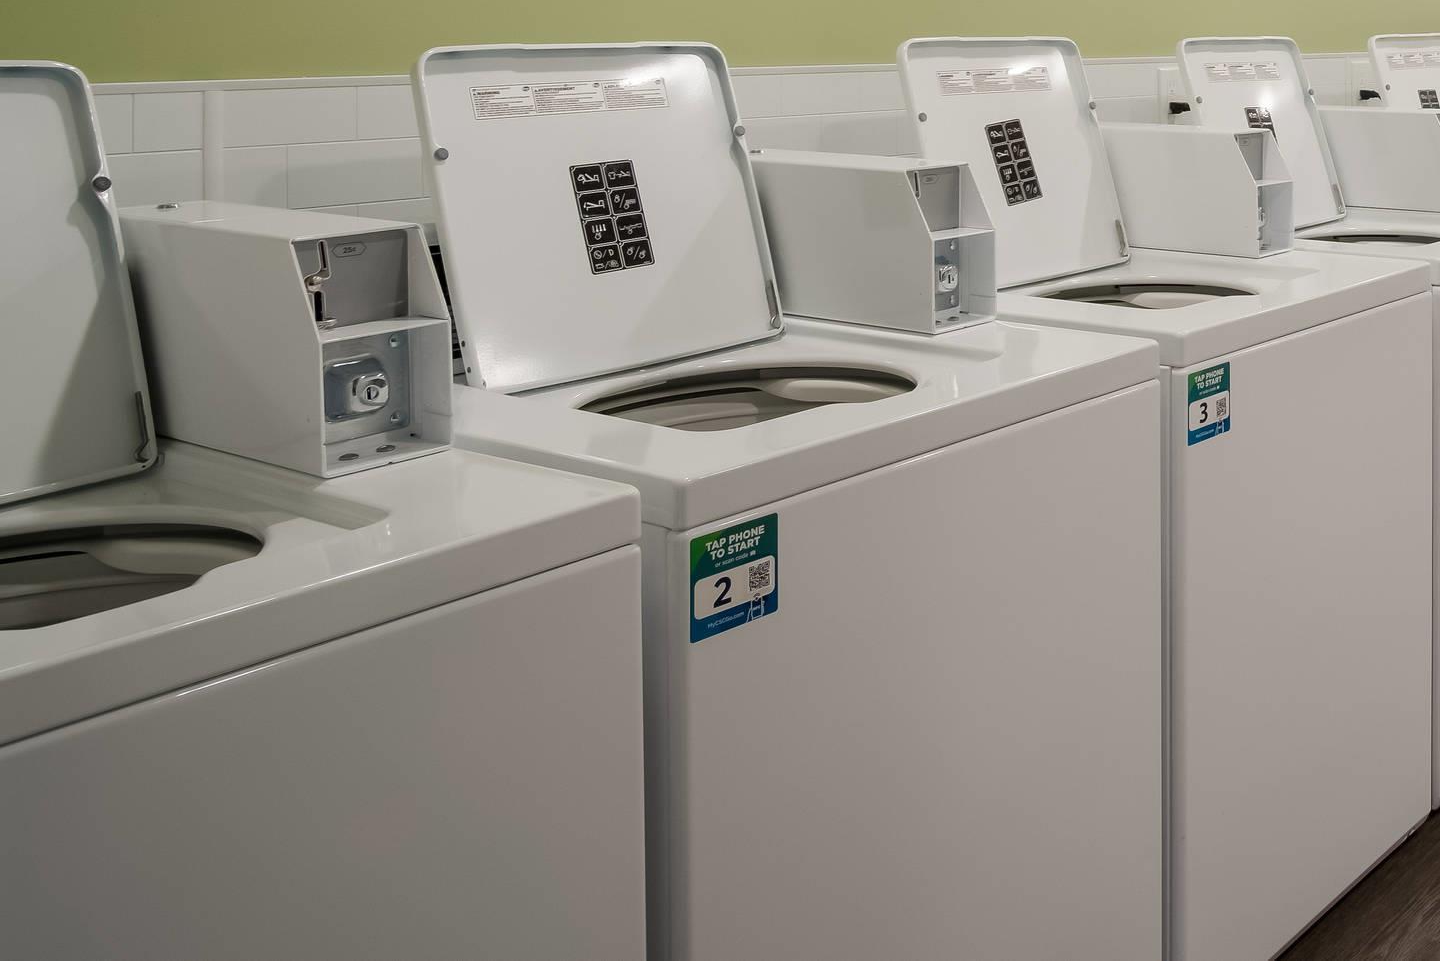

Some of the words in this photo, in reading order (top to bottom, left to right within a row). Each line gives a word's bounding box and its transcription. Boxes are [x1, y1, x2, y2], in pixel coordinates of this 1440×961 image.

[1195, 374, 1205, 383] TAP
[1206, 367, 1225, 379] PHONE
[1197, 382, 1205, 390] TO
[1205, 376, 1222, 387] START
[1199, 402, 1208, 424] 3
[705, 537, 726, 552] TAP
[728, 524, 765, 544] PHONE
[710, 548, 726, 560] TO
[727, 536, 761, 555] START
[713, 576, 732, 609] 2
